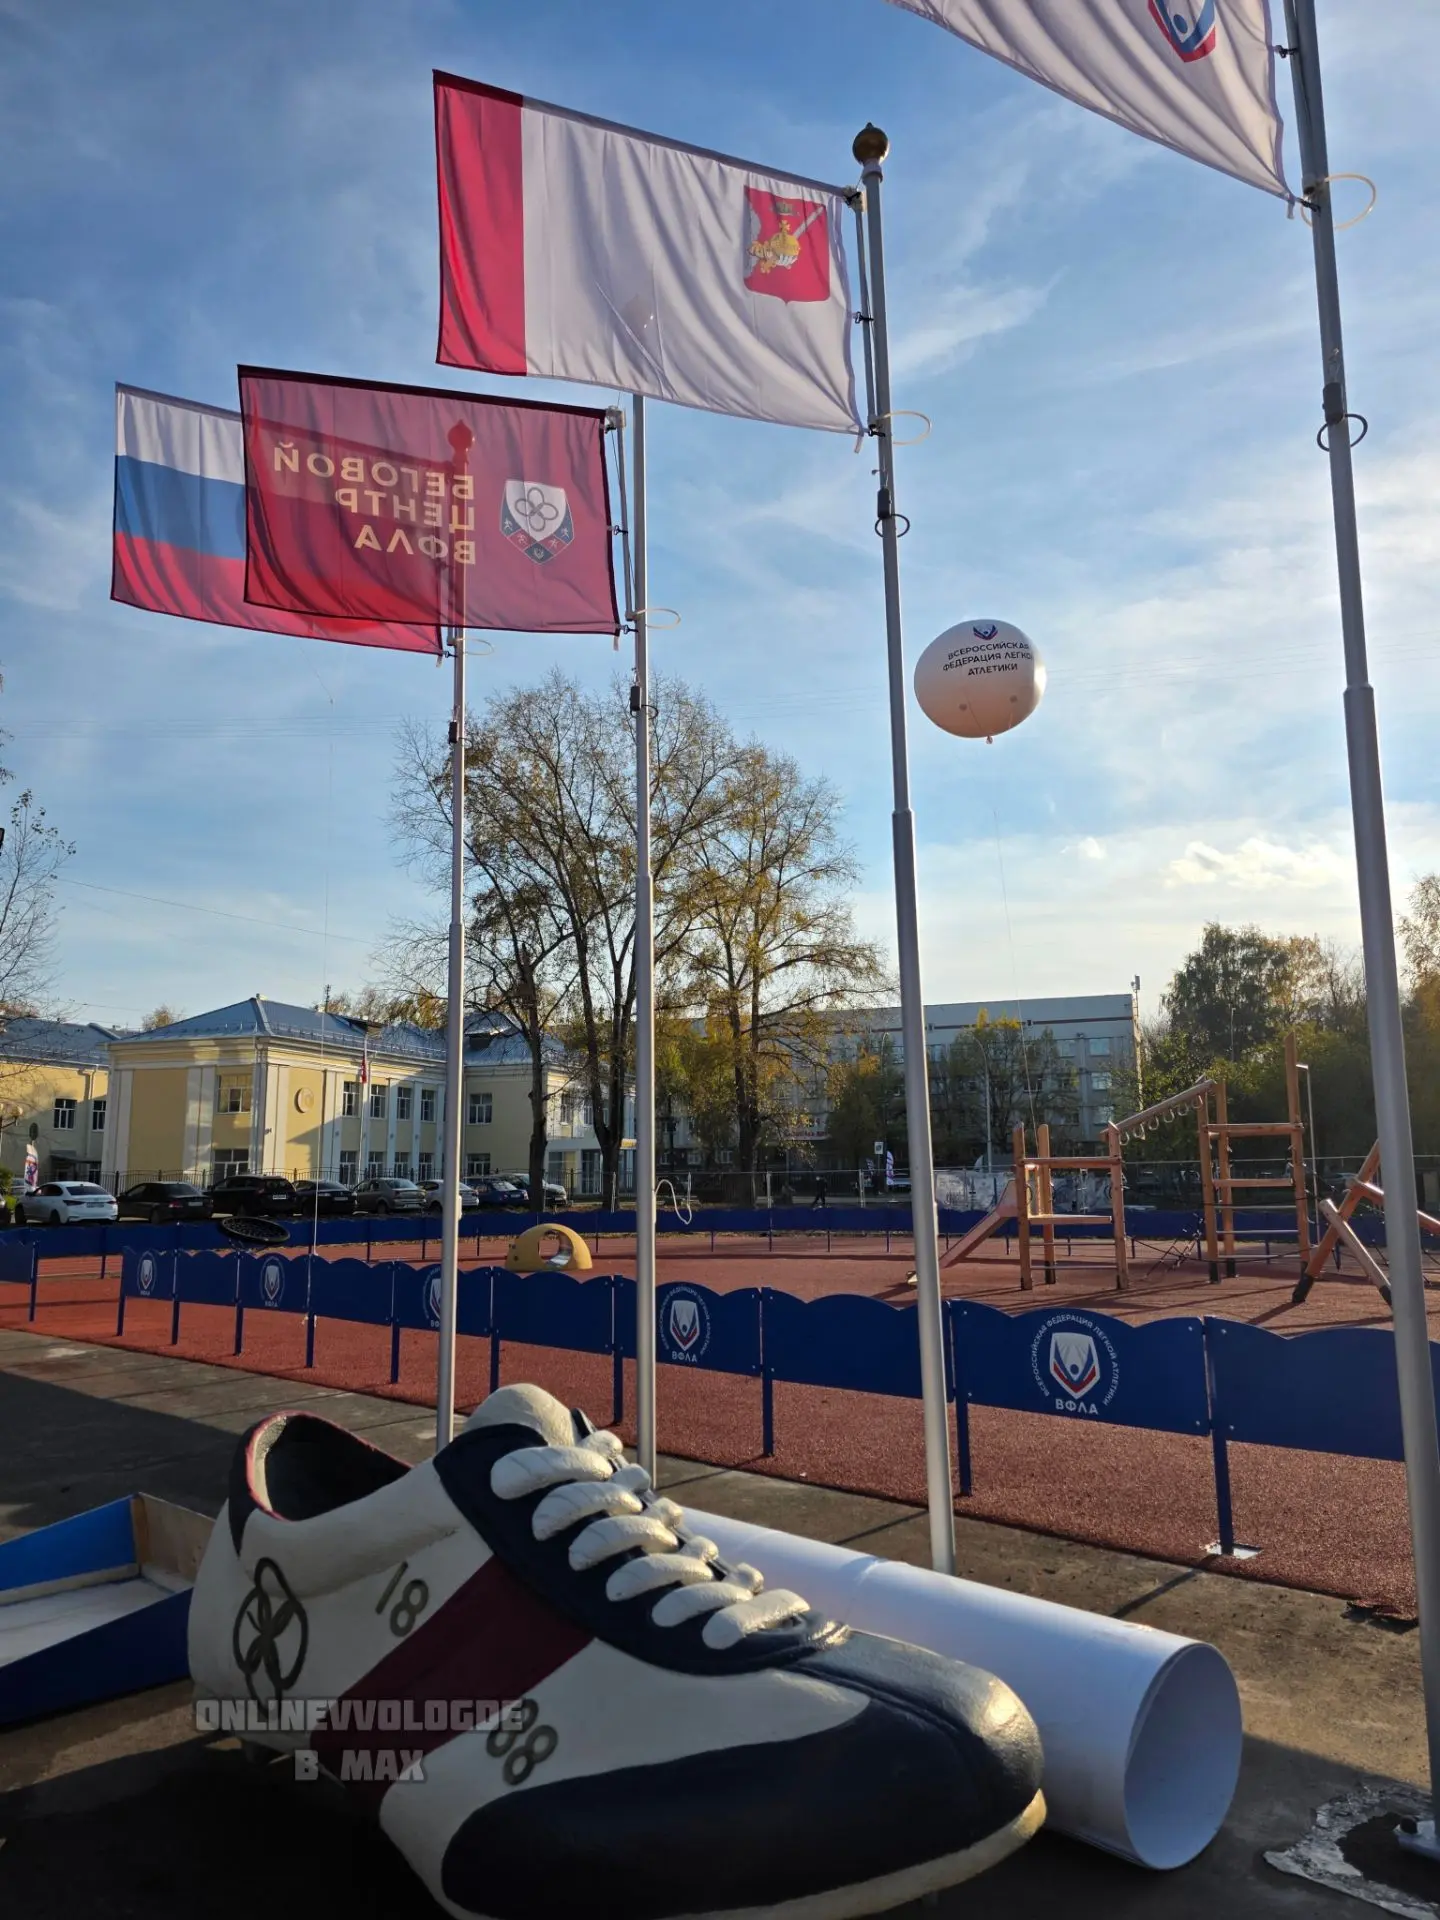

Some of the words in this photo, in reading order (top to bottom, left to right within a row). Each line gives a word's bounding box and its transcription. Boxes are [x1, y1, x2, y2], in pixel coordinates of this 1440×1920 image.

[942, 652, 1001, 672] ФЕДЕРАЦИЯ
[1004, 651, 1033, 660] ЛЕГКО
[967, 663, 1018, 676] АТЛЕТИКИ
[1046, 1314, 1093, 1328] ФЕДЕРАЦИЯ
[1092, 1326, 1118, 1360] ЛЕГКОЙ
[671, 1351, 698, 1363] ВФЛА
[1102, 1361, 1120, 1406] АТЛЕТИКИ
[1055, 1398, 1099, 1415] ВФЛА
[374, 1560, 429, 1638] 18
